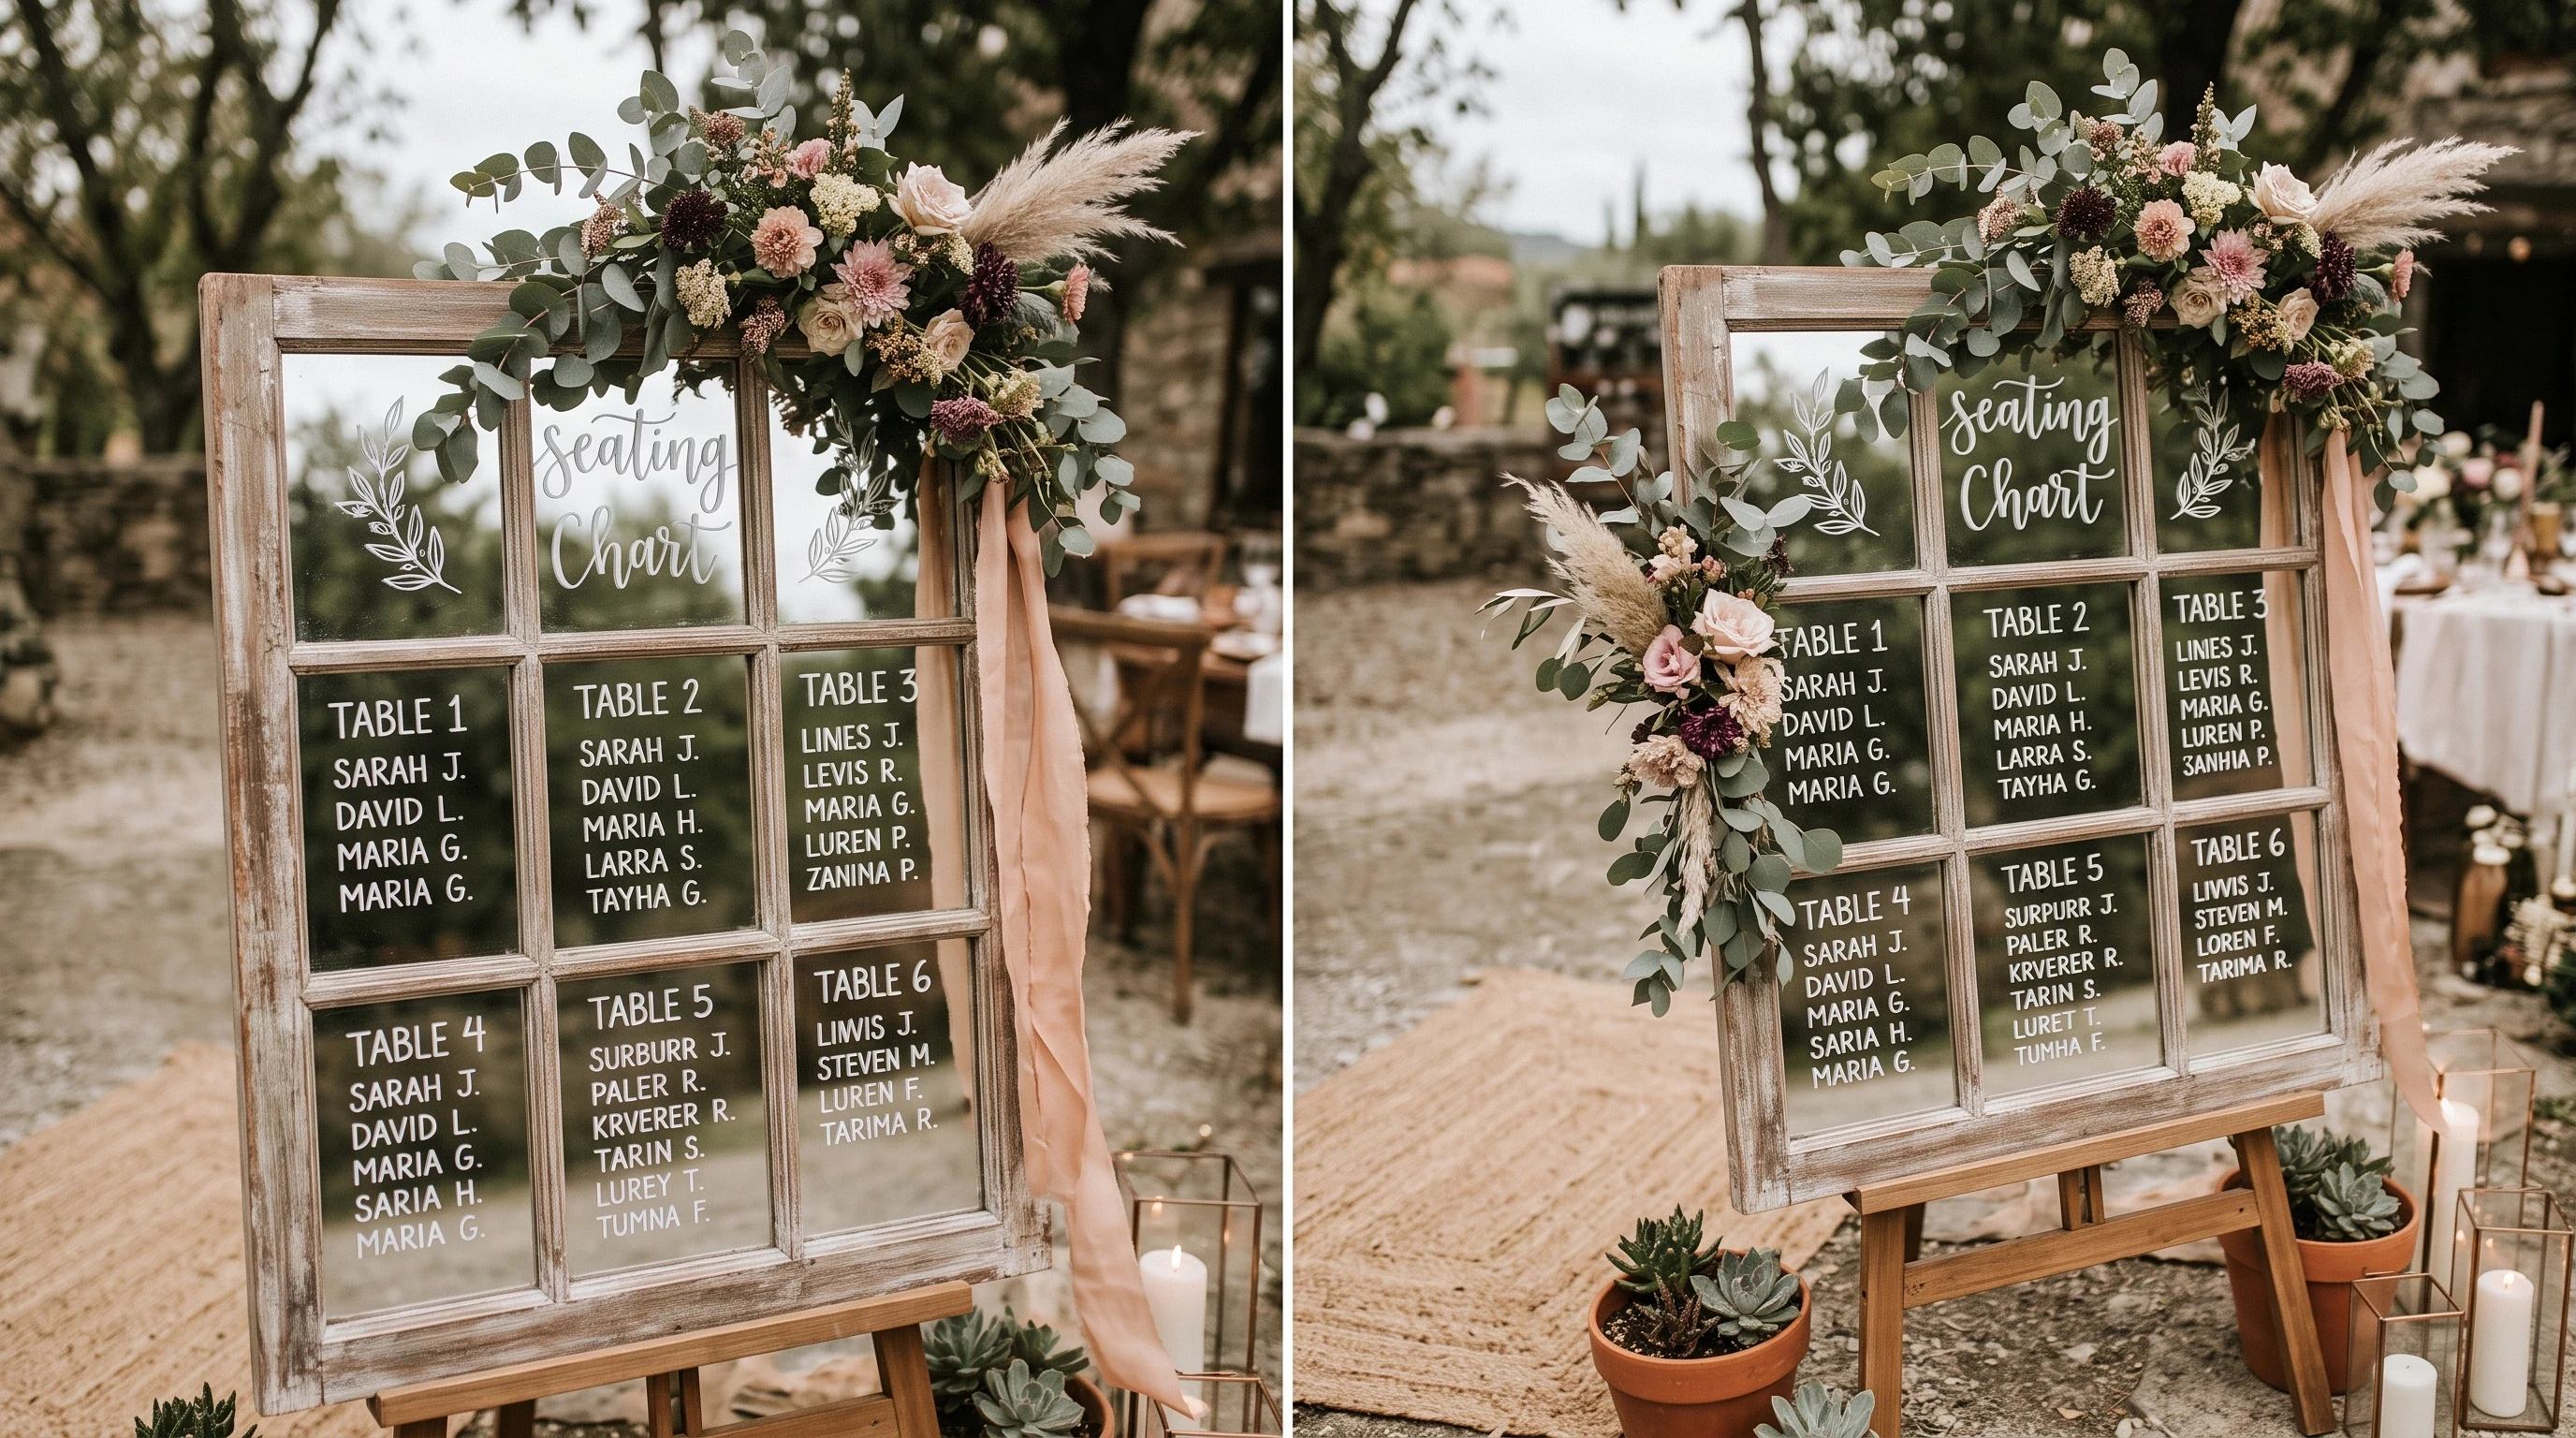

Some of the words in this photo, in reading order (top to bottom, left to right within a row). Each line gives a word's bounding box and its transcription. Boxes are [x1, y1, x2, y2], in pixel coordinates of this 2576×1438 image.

[1960, 458, 2115, 531] Chart
[551, 506, 733, 589] Chart
[1983, 605, 2063, 638] TABLE
[2072, 601, 2089, 632] 2
[2173, 592, 2245, 624] TABLE
[2252, 589, 2269, 619] 3
[1871, 619, 1888, 652] 1
[2241, 635, 2258, 656] J.
[1989, 651, 2057, 679] SARAH
[2067, 649, 2087, 671] J.
[2178, 666, 2231, 692] LEVIS
[2239, 664, 2258, 685] R.
[573, 681, 669, 719] TABLE
[682, 679, 702, 714] 2
[799, 670, 887, 707] TABLE
[899, 668, 918, 702] 3
[1778, 671, 1856, 701] SARAH
[1867, 668, 1887, 694] J.
[1992, 683, 2056, 711] DAVID
[2066, 681, 2086, 702] L.
[328, 697, 432, 739] TABLE
[448, 694, 467, 732] 1
[1783, 707, 1853, 737] DAVID
[1864, 704, 1885, 727] L.
[2180, 694, 2243, 720] MARIA
[2249, 691, 2269, 712] G.
[801, 724, 871, 753] LINES
[883, 722, 903, 748] J.
[1994, 713, 2061, 741] MARIA
[2070, 711, 2092, 732] H.
[2182, 722, 2243, 748] LUREN
[2250, 719, 2265, 740] P.
[579, 737, 663, 768] SARAH
[677, 735, 699, 761] J.
[1785, 741, 1859, 771] MARIA
[1867, 738, 1890, 761] G.
[1997, 743, 2064, 770] LARRA
[2072, 740, 2092, 762] S.
[2257, 746, 2273, 767] P.
[333, 755, 427, 789] SARAH
[442, 752, 465, 781] J.
[803, 759, 868, 788] LEVIS
[880, 758, 903, 783] R.
[1788, 774, 1864, 805] MARIA
[1873, 771, 1896, 795] G.
[1998, 773, 2068, 800] TAYHA
[2075, 770, 2096, 790] G.
[581, 775, 661, 806] DAVID
[673, 774, 696, 799] L.
[805, 794, 882, 823] MARIA
[892, 791, 915, 815] G.
[335, 798, 422, 830] DAVID
[438, 795, 464, 823] L.
[583, 812, 666, 843] MARIA
[677, 809, 703, 834] H.
[337, 837, 430, 872] MARIA
[441, 833, 468, 861] G.
[806, 828, 881, 858] LUREN
[891, 826, 910, 849] P.
[2190, 831, 2261, 866] TABLE
[2269, 828, 2285, 857] 6
[585, 848, 668, 879] LARRA
[680, 844, 702, 870] S.
[806, 860, 890, 890] ZANINA
[900, 858, 918, 881] P.
[2000, 857, 2078, 893] TABLE
[2086, 853, 2103, 881] 5
[340, 877, 432, 913] MARIA
[446, 873, 473, 902] G.
[586, 883, 671, 914] TAYHA
[682, 880, 707, 905] G.
[2257, 872, 2274, 892] J.
[1798, 890, 1883, 930] TABLE
[1892, 886, 1910, 915] 4
[2005, 897, 2092, 929] SURPURR
[2100, 893, 2117, 915] J.
[2194, 901, 2260, 930] STEVEN
[2267, 897, 2288, 917] M.
[1804, 934, 1877, 967] SARAH
[1888, 930, 1908, 953] J.
[2006, 929, 2070, 956] PALER
[2078, 925, 2098, 945] R.
[2197, 928, 2257, 957] LOREN
[2263, 925, 2280, 945] F.
[813, 963, 901, 1004] TABLE
[913, 960, 931, 993] 6
[1806, 968, 1873, 998] DAVID
[1885, 964, 1906, 984] L.
[2009, 951, 2095, 983] KRVERER
[2104, 947, 2123, 968] R.
[2197, 954, 2267, 983] TARIMA
[2274, 950, 2292, 970] R.
[588, 988, 681, 1030] TABLE
[693, 984, 713, 1019] 5
[1808, 996, 1880, 1029] MARIA
[1888, 991, 1910, 1014] G.
[2010, 982, 2074, 1011] TARIN
[2084, 979, 2100, 1000] S.
[897, 1011, 916, 1036] J.
[1810, 1027, 1880, 1060] SARIA
[1890, 1021, 1912, 1045] H.
[2013, 1010, 2076, 1040] LURET
[2083, 1006, 2100, 1026] T.
[345, 1021, 449, 1067] TABLE
[462, 1015, 486, 1052] 4
[589, 1037, 698, 1072] SURBURR
[710, 1032, 730, 1058] J.
[2014, 1036, 2082, 1065] TUMHA
[2091, 1032, 2106, 1051] F.
[817, 1047, 900, 1080] STEVEN
[910, 1043, 935, 1068] M.
[1812, 1056, 1884, 1089] MARIA
[1894, 1050, 1915, 1073] G.
[349, 1074, 442, 1112] SARAH
[457, 1069, 479, 1097] J.
[592, 1073, 668, 1107] PALER
[682, 1069, 706, 1093] R.
[820, 1080, 893, 1113] LUREN
[905, 1077, 923, 1100] F.
[352, 1114, 437, 1151] DAVID
[452, 1108, 477, 1135] L.
[593, 1103, 699, 1140] KRVERER
[712, 1098, 736, 1123] R.
[820, 1111, 907, 1146] TARIMA
[917, 1108, 938, 1131] R.
[353, 1149, 443, 1186] MARIA
[455, 1144, 483, 1170] G.
[593, 1138, 672, 1172] TARIN
[684, 1136, 705, 1160] S.
[355, 1185, 442, 1223] SARIA
[456, 1179, 483, 1207] H.
[596, 1172, 672, 1208] LUREY
[683, 1168, 704, 1192] T.
[596, 1205, 681, 1238] TUMNA
[694, 1199, 710, 1224] F.
[357, 1221, 446, 1258] MARIA
[459, 1215, 485, 1241] G.
